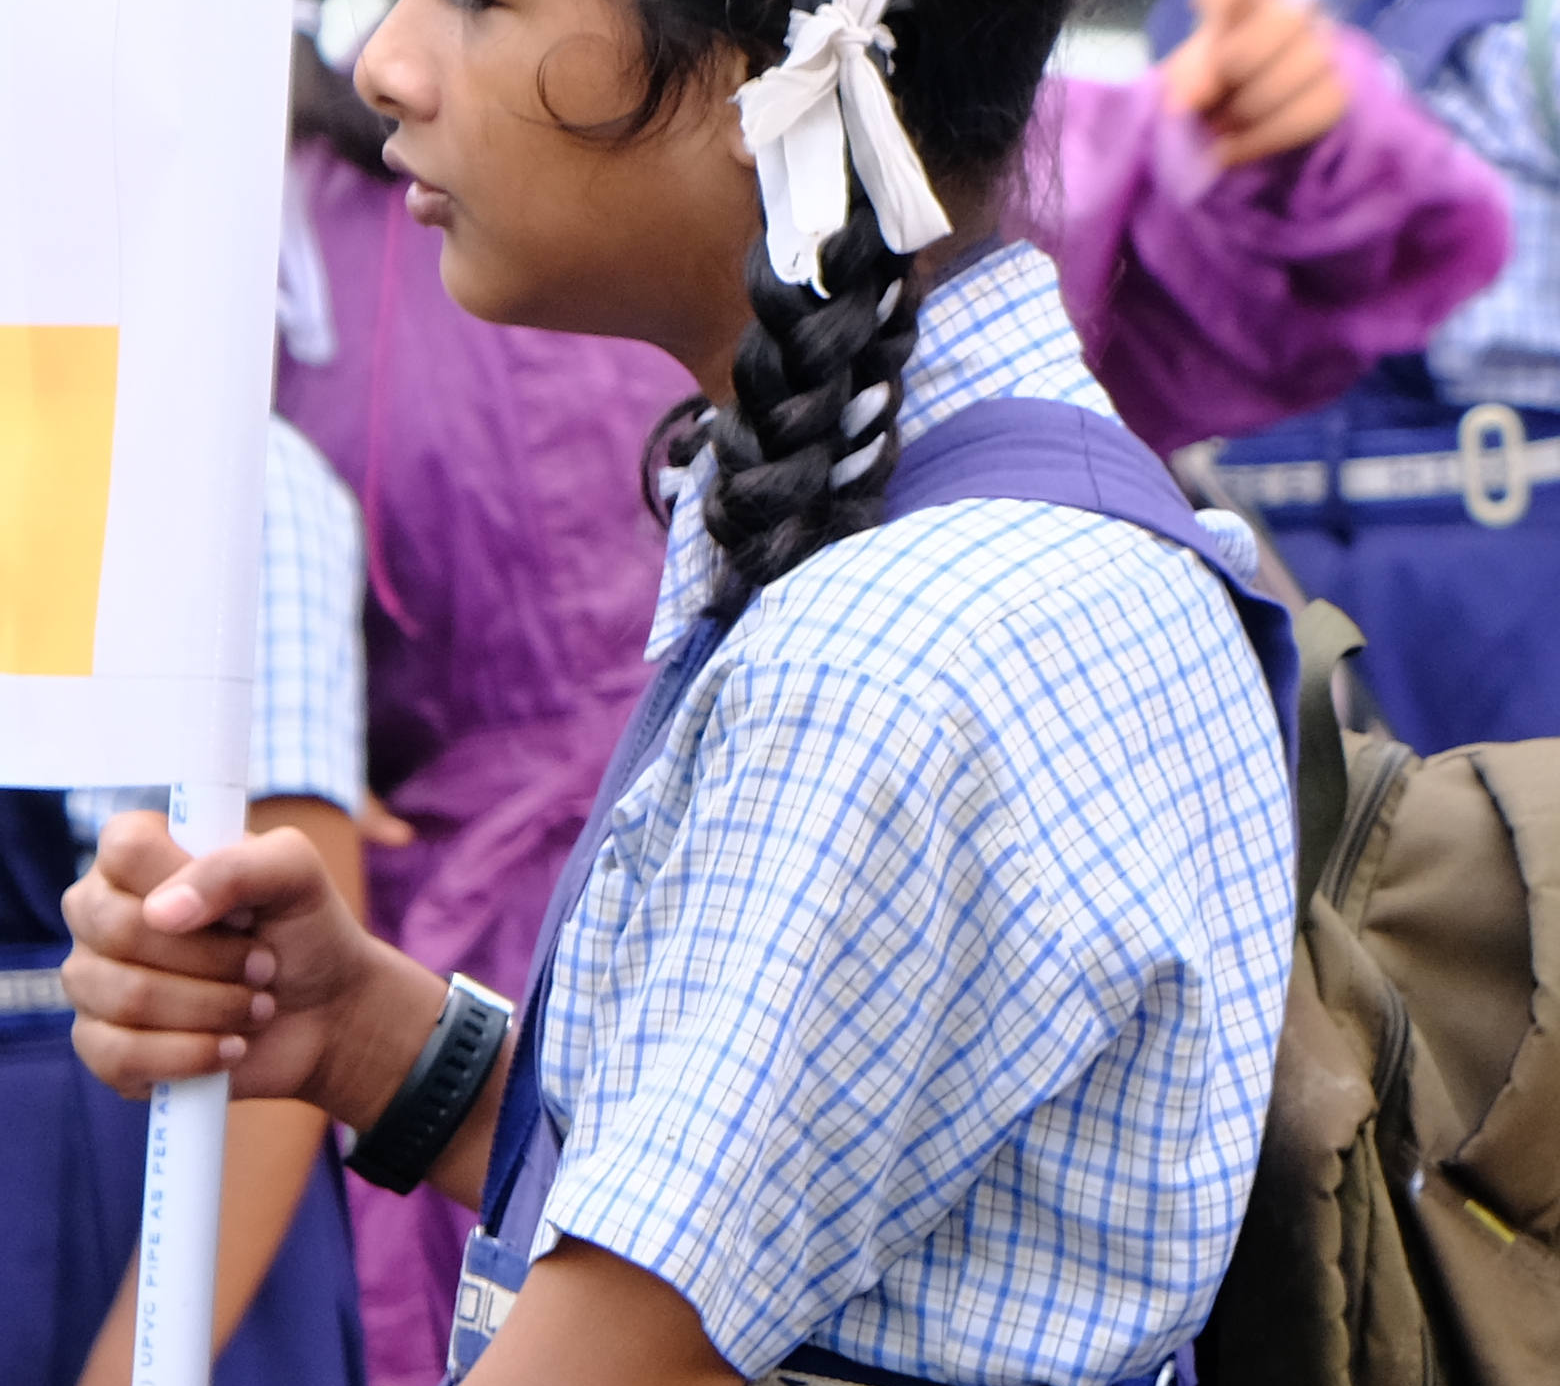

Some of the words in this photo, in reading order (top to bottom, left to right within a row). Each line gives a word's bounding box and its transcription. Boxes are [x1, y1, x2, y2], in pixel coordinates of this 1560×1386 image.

[151, 1126, 167, 1175] PER
[145, 1232, 162, 1288] PIPE
[140, 1300, 157, 1368] UPVC
